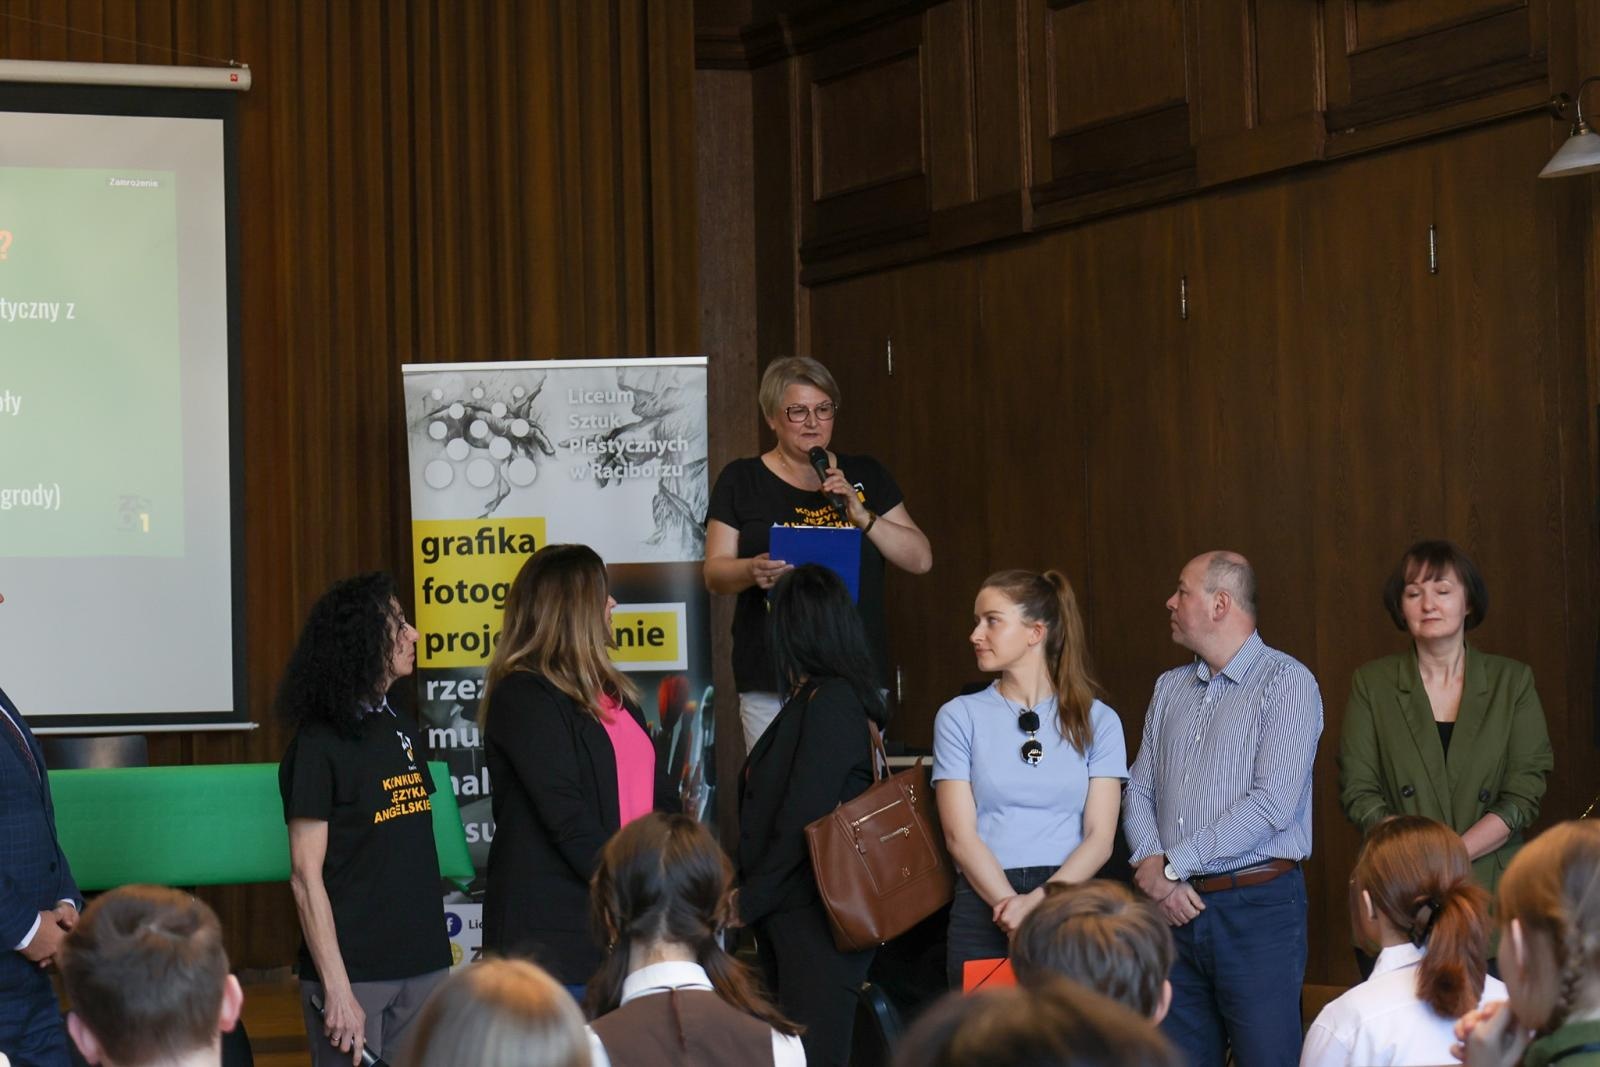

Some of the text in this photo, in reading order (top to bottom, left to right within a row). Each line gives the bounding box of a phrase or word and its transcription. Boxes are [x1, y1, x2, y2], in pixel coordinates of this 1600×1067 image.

[0, 297, 75, 323] tyczny z
[568, 388, 634, 404] Liceum
[569, 413, 620, 429] Sztuk
[570, 435, 688, 457] Plastycznych
[571, 461, 684, 480] w Raciborzu
[0, 483, 60, 511] grody)
[421, 526, 536, 564] grafika
[422, 576, 511, 609] fotog
